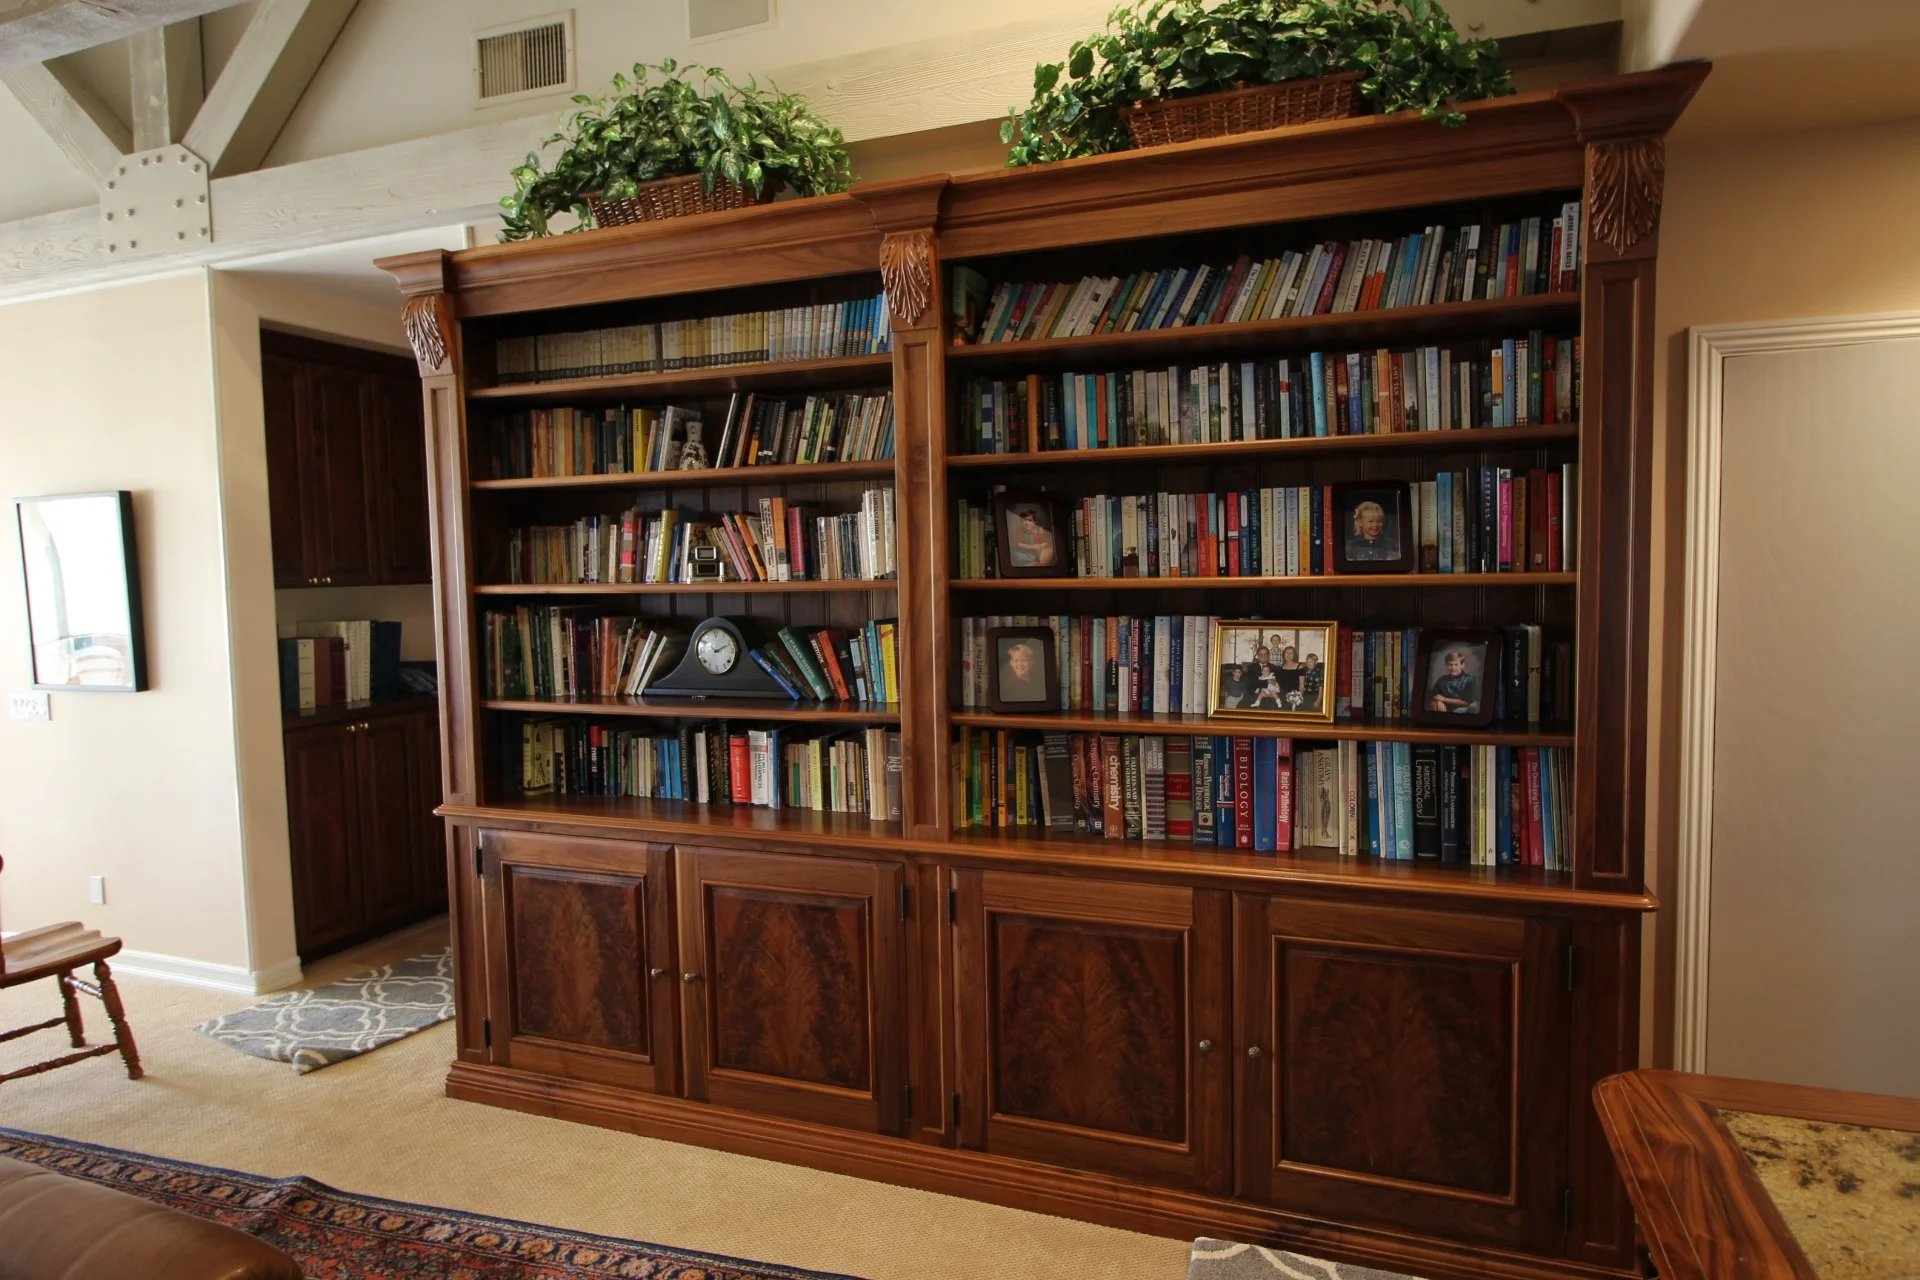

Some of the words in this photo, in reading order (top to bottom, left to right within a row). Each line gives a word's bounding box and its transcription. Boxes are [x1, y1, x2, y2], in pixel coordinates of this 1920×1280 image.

[788, 640, 804, 660] HARRY
[810, 639, 824, 664] ZEITOUN
[1072, 754, 1080, 778] Organic
[1090, 742, 1098, 771] Organic
[1092, 772, 1100, 809] Chemistry
[1108, 755, 1121, 811] chemistry
[1240, 756, 1248, 818] BIOLOGY
[1281, 771, 1290, 790] Basic
[1396, 786, 1403, 794] of
[1415, 765, 1423, 814] PHYSIOLOGY
[1279, 791, 1289, 822] Pathology
[1396, 795, 1404, 829] Anatomy
